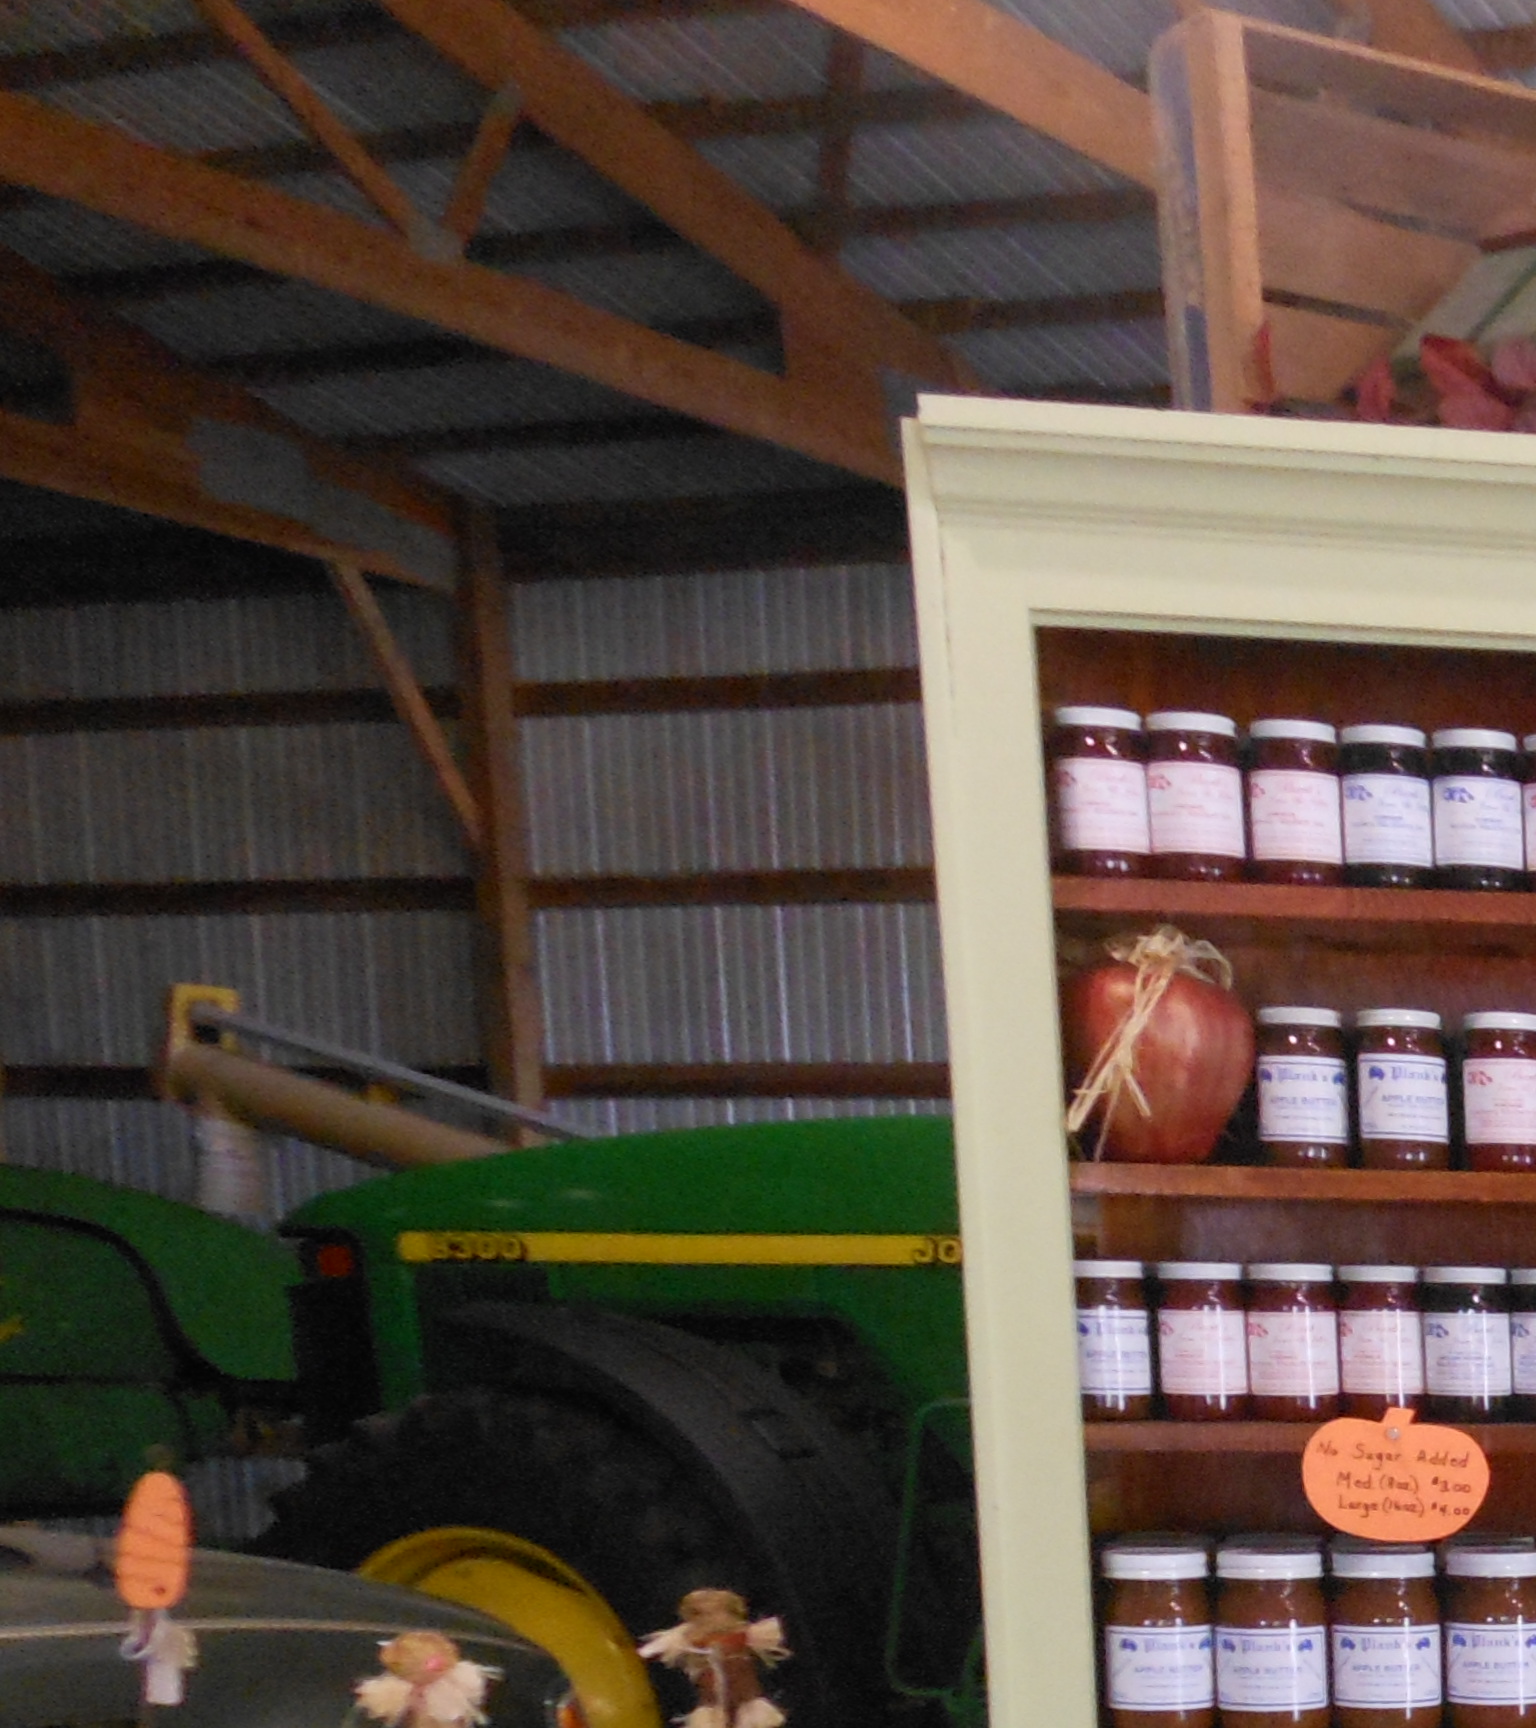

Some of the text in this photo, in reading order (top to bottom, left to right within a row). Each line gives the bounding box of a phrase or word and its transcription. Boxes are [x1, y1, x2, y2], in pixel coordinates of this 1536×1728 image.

[1352, 1443, 1401, 1470] Sugar
[1416, 1449, 1469, 1468] Added
[1338, 1494, 1377, 1518] Large
